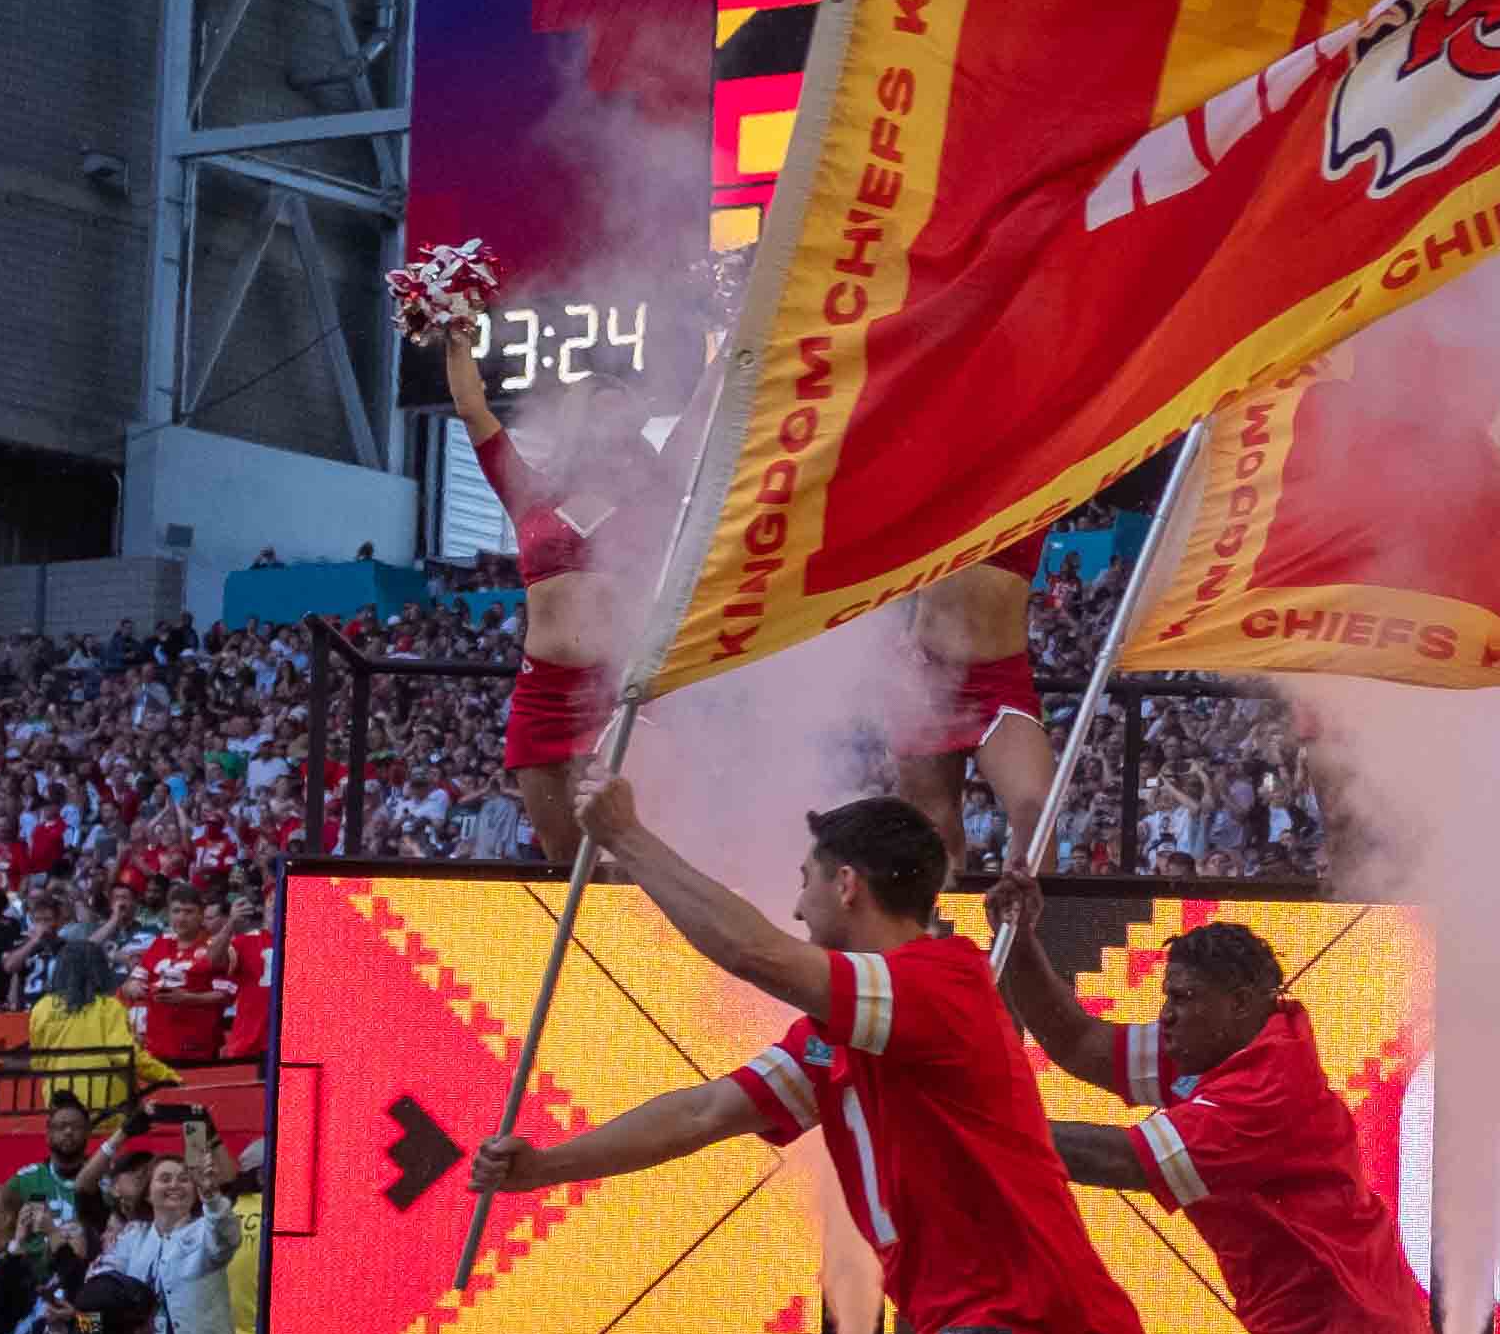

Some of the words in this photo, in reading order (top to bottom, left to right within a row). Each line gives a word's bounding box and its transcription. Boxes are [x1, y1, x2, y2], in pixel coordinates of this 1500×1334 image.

[708, 335, 835, 665] KINGDOM
[819, 66, 916, 328] CHIEFS
[1157, 382, 1276, 642] KINGDOM
[1240, 608, 1459, 662] CHIEFS
